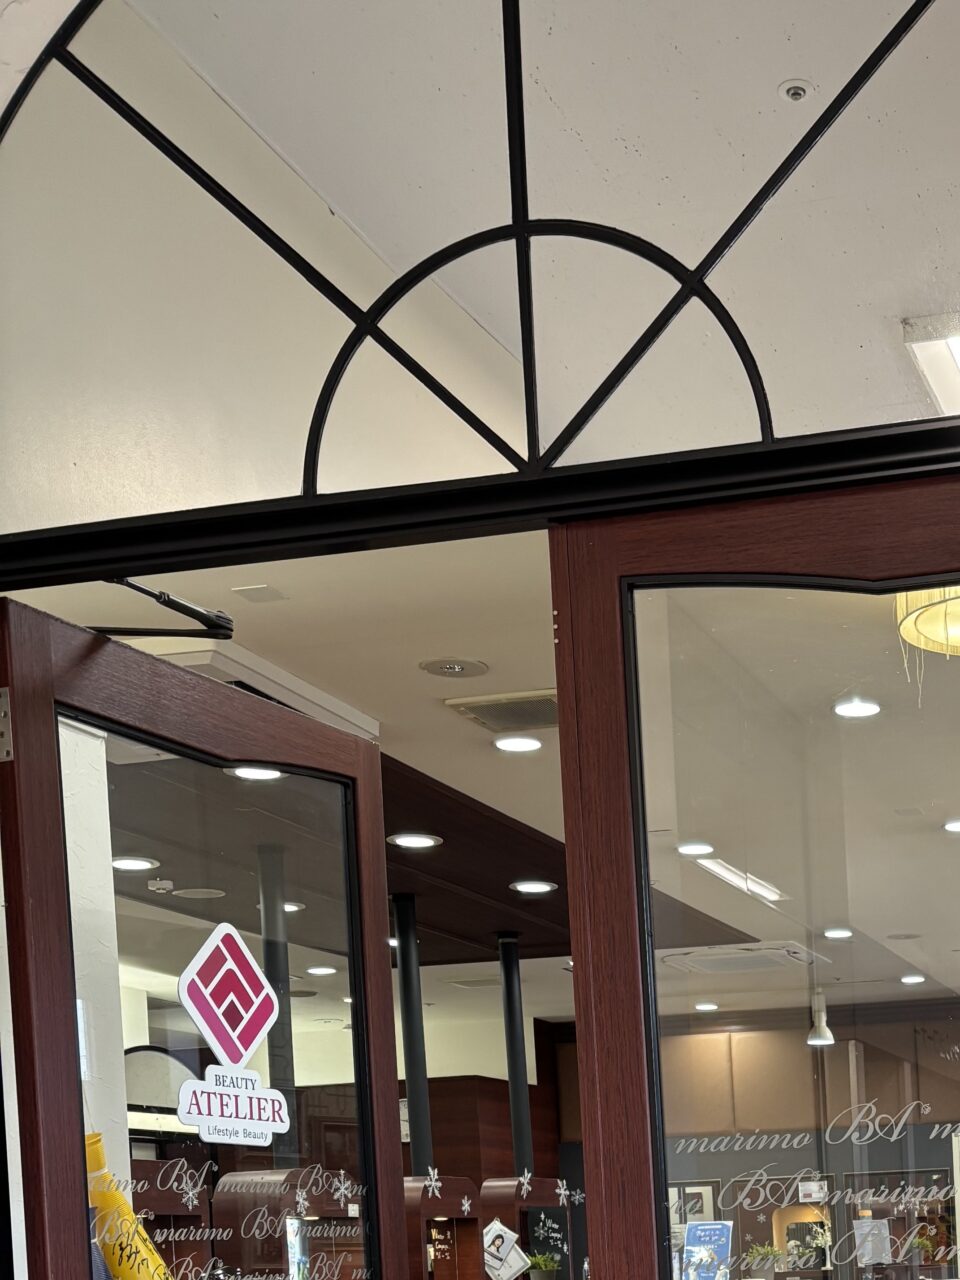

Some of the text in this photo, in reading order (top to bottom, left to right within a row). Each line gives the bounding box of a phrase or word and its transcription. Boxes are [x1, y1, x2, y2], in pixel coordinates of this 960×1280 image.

[214, 1074, 258, 1091] BEAUTY
[186, 1090, 286, 1124] ATELIER
[207, 1125, 269, 1142] Lifestyle Beauty
[674, 1128, 814, 1154] marimo
[825, 1098, 922, 1145] BA
[157, 1158, 214, 1192] BA
[717, 1163, 812, 1211] BA
[820, 1181, 958, 1206] marimo
[153, 1217, 233, 1242] marimo
[240, 1204, 292, 1239] BA
[296, 1216, 361, 1238] marimo
[832, 1217, 925, 1265] BA
